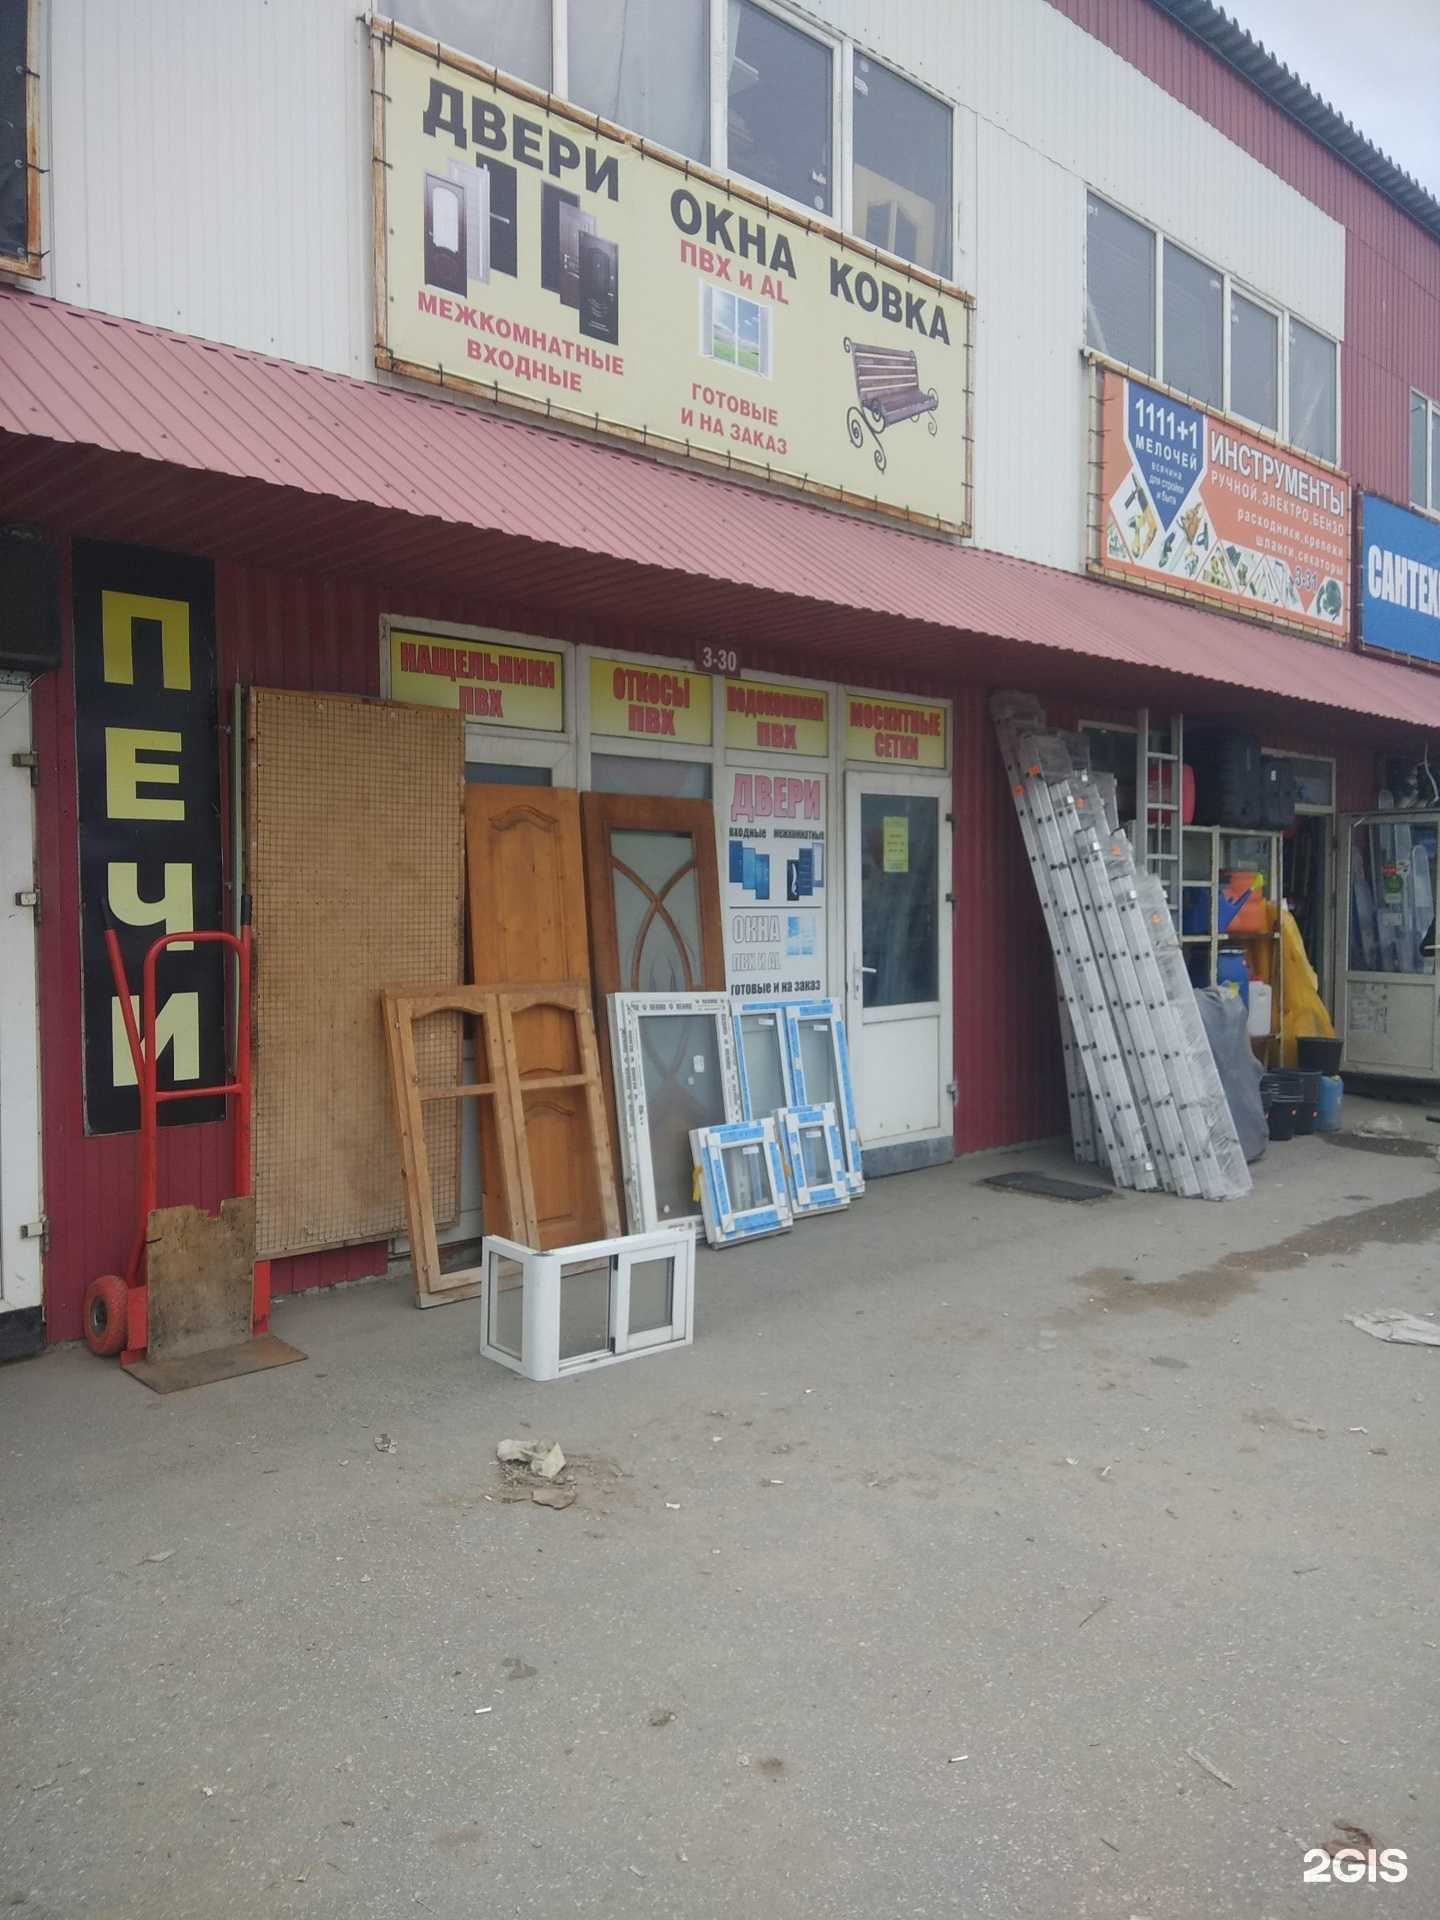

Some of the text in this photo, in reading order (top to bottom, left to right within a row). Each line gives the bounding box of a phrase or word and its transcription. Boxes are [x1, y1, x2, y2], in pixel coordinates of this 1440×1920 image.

[423, 77, 620, 202] ДВЕРИ
[670, 188, 797, 280] ОКНА
[680, 239, 731, 290] ПВХ
[761, 274, 790, 305] AL
[830, 257, 951, 347] КОВКА
[417, 291, 624, 377] МЕЖКОМНАТНЫЕ
[466, 338, 582, 394] ВХОДНЫЕ
[691, 382, 779, 427] ГОТОВЫЕ
[1135, 398, 1198, 450] 1111+1
[680, 408, 788, 456] И НА ЗАКАЗ
[1135, 433, 1198, 472] МЕЛОЧЕЙ
[1211, 430, 1345, 518] ИНСТРУМЕНТЫ
[1368, 544, 1440, 619] САНТЕХ
[400, 642, 555, 689] НАЩЕЛЬНИКИ
[702, 646, 737, 672] 3-30
[459, 685, 504, 718] ПВХ
[612, 667, 690, 709] ОТКОСЫ
[628, 704, 676, 736] ПВХ
[756, 721, 797, 750] ПВХ
[850, 702, 940, 737] МОСКИТНЫЕ
[874, 732, 919, 760] СЕТКИ
[731, 773, 821, 823] ДВЕРИ
[102, 590, 200, 1087] ПЕЧИ
[732, 915, 781, 943] ОКНА
